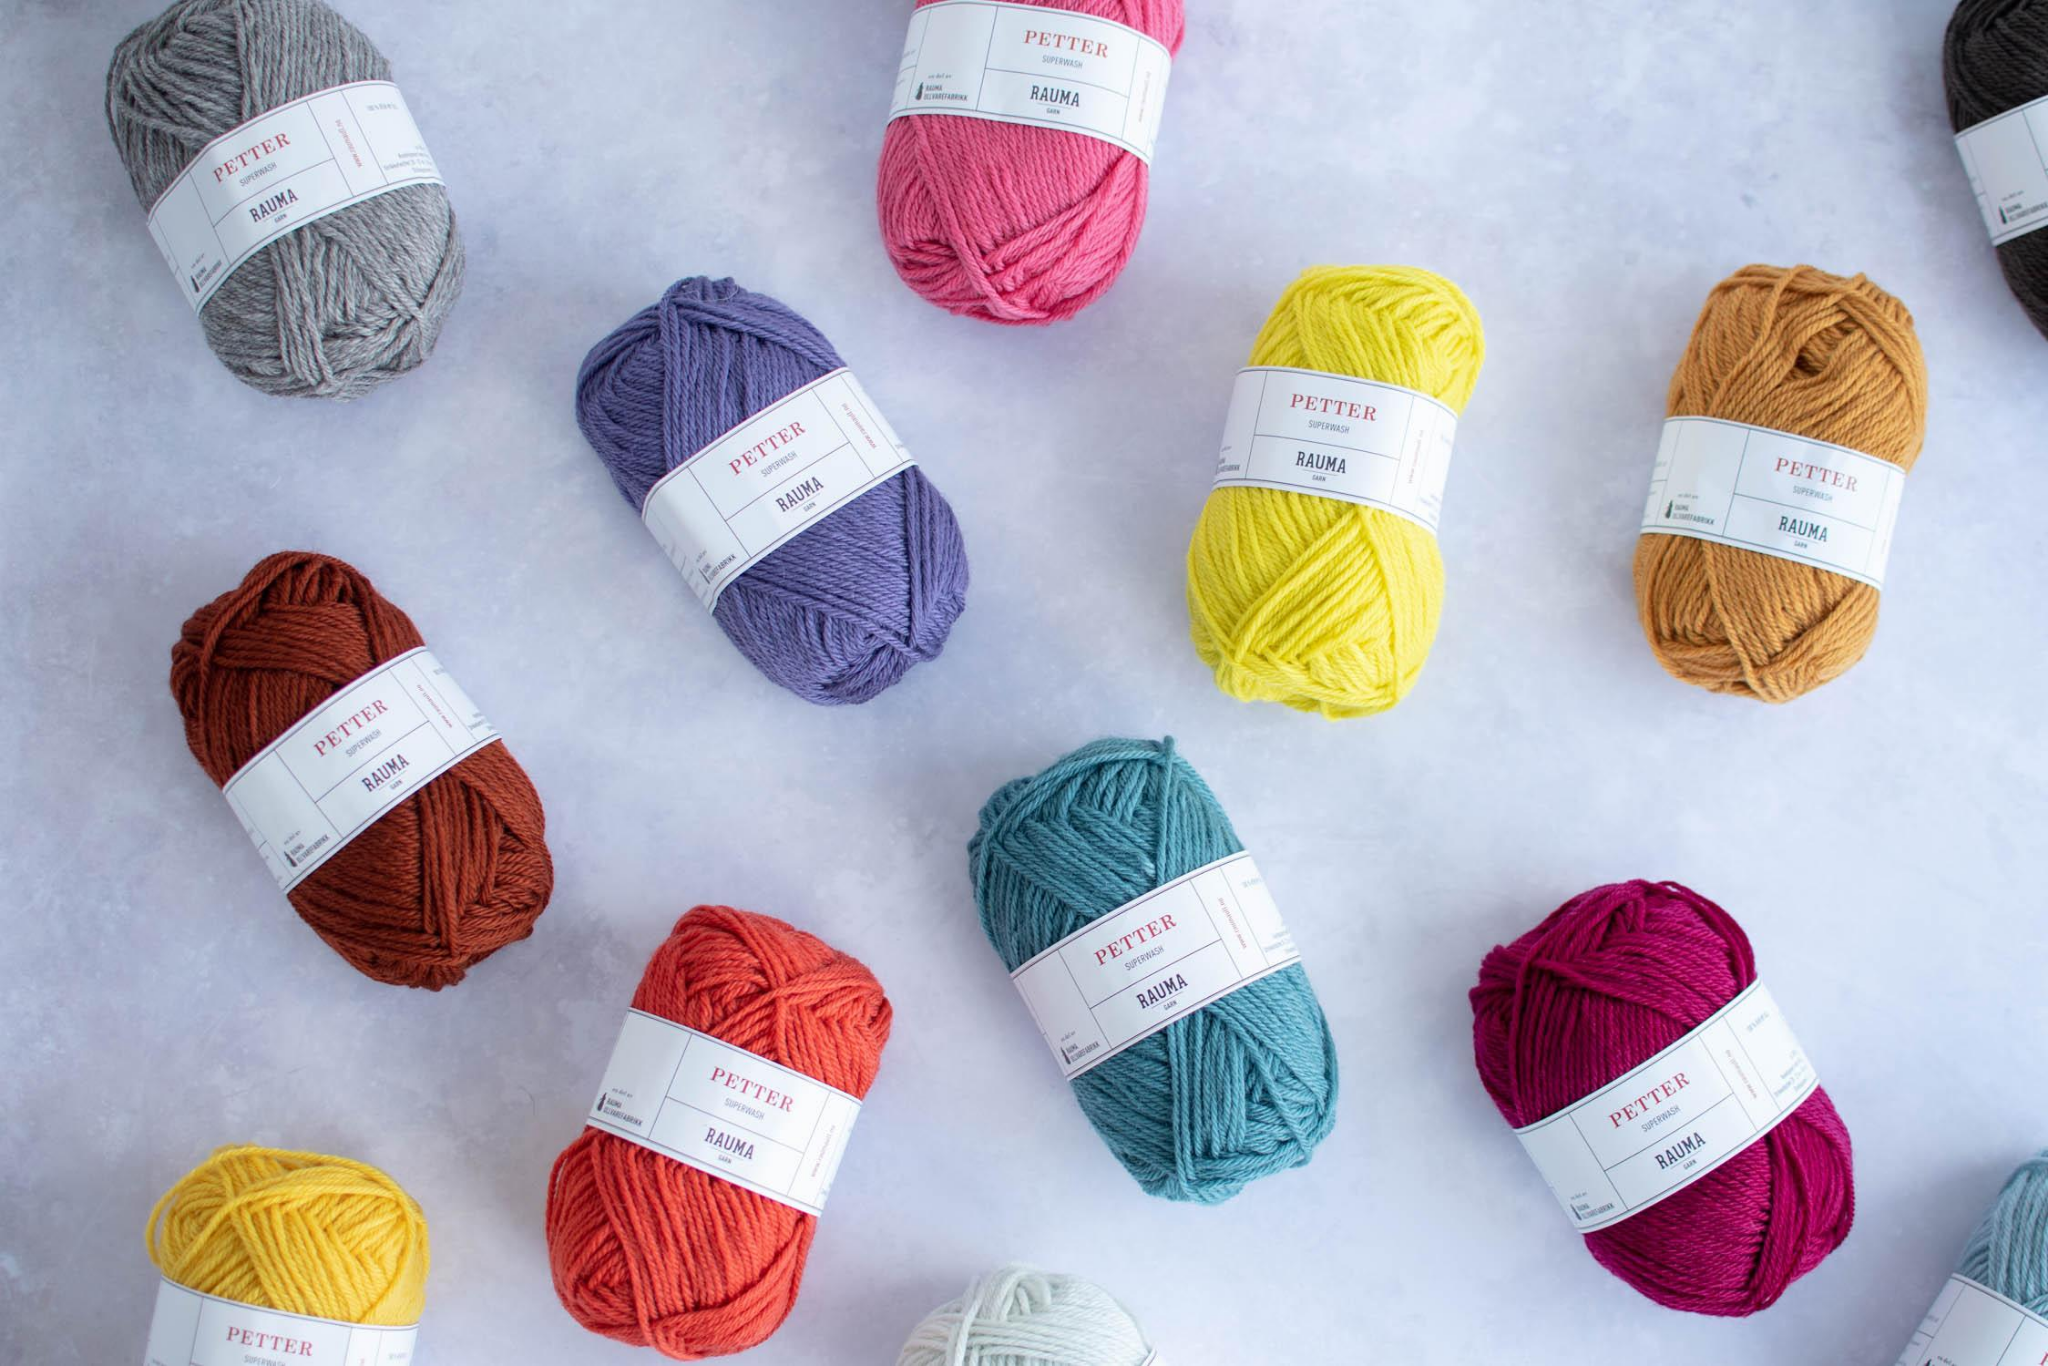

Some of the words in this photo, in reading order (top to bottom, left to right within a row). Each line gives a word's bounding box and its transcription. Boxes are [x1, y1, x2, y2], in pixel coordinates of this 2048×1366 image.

[1024, 30, 1107, 57] PETTER
[1042, 55, 1082, 68] SUPERWASH
[1030, 85, 1079, 107] RAUMA
[213, 134, 291, 184] PETTER
[240, 162, 276, 186] SUPERWASH
[249, 189, 298, 222] RAUMA
[274, 214, 286, 223] GARN
[1290, 394, 1377, 421] PETTER
[1308, 420, 1349, 433] SUPERWASH
[729, 422, 804, 475] PETTER
[761, 452, 797, 477] SUPERWASH
[1296, 452, 1345, 473] RAUMA
[1776, 458, 1858, 492] PETTER
[776, 477, 824, 512] RAUMA
[1793, 485, 1833, 501] SUPERWASH
[804, 502, 816, 512] GARN
[1778, 516, 1829, 542] RAUMA
[314, 700, 388, 757] PETTER
[345, 729, 380, 758] SUPERWASH
[362, 754, 409, 792] RAUMA
[390, 780, 402, 790] GARN
[1094, 915, 1176, 966] PETTER
[1124, 947, 1164, 971] SUPERWASH
[1136, 974, 1188, 1009] RAUMA
[1164, 1000, 1177, 1010] GARN
[710, 1067, 793, 1112] PETTER
[1609, 1073, 1689, 1128] PETTER
[724, 1098, 764, 1119] SUPERWASH
[1641, 1106, 1680, 1132] SUPERWASH
[705, 1128, 754, 1159] RAUMA
[1655, 1133, 1706, 1169] RAUMA
[718, 1155, 731, 1164] GARN
[1684, 1160, 1696, 1170] GARN
[226, 1326, 313, 1356] PETTER
